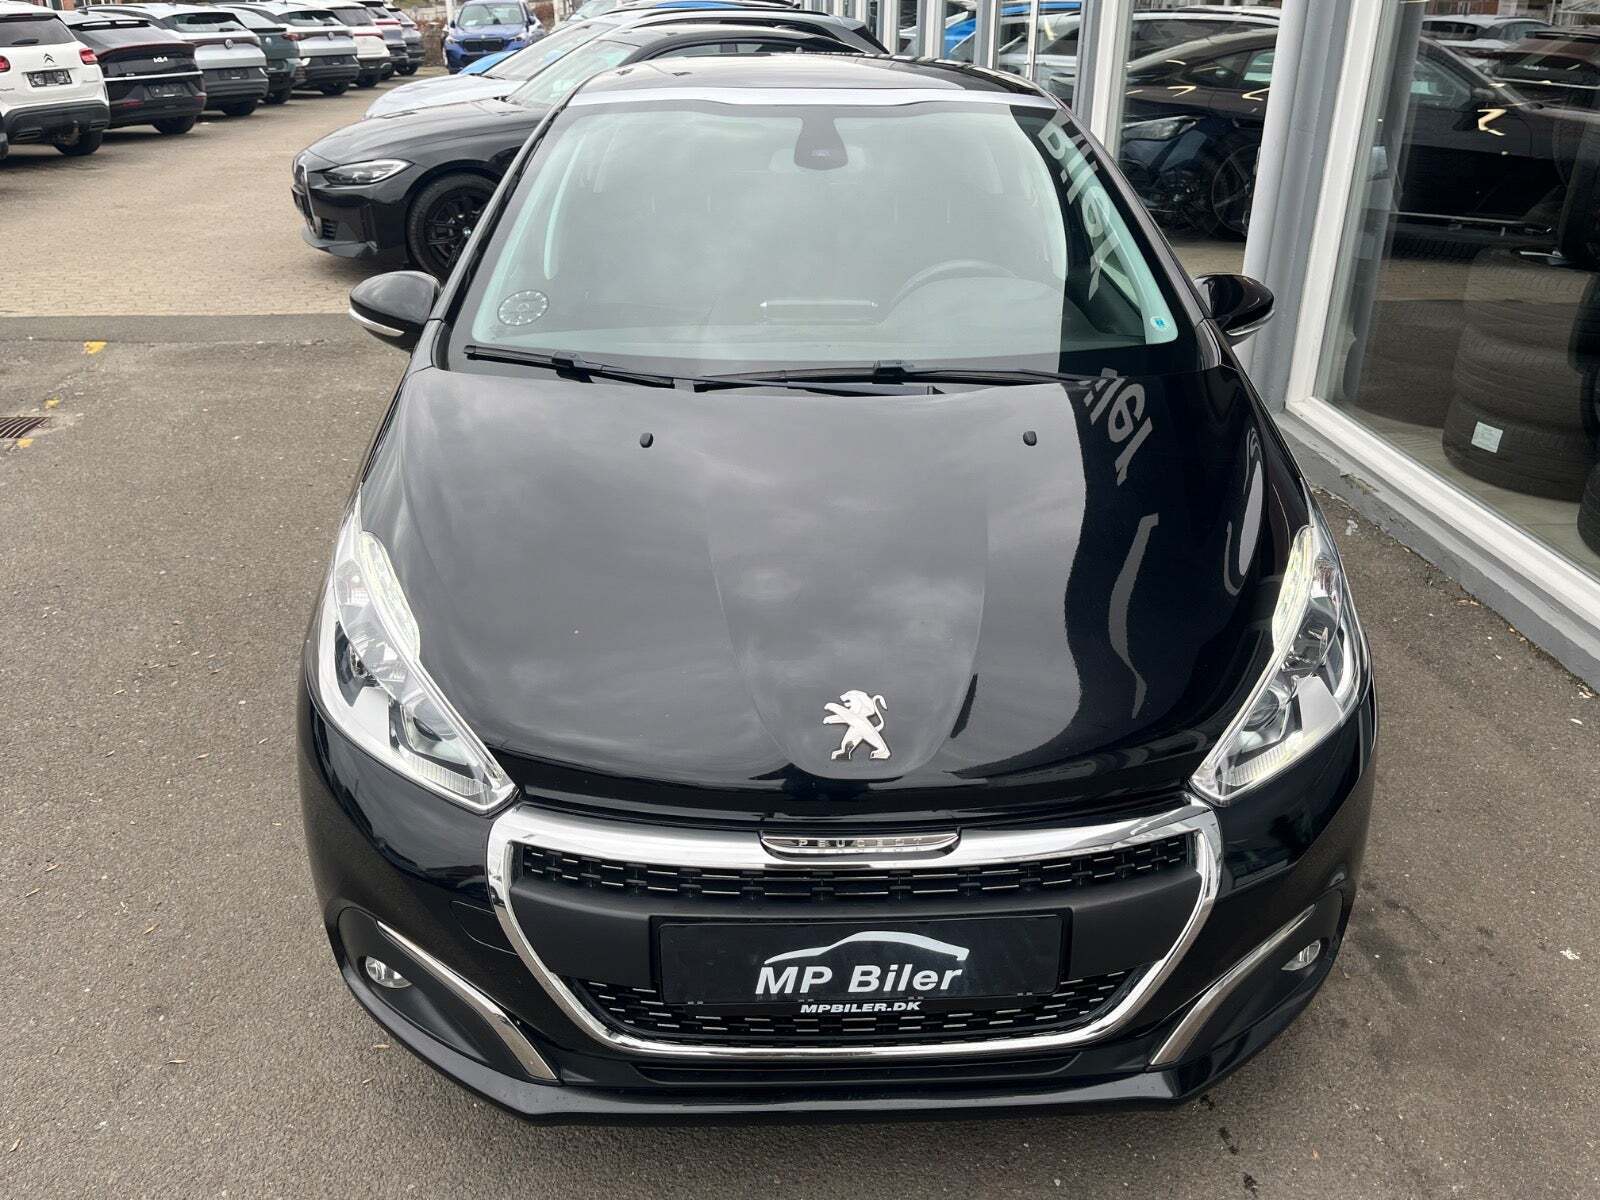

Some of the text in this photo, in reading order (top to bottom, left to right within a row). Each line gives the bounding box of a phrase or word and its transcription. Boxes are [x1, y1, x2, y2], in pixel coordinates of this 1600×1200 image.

[755, 963, 963, 995] MP Biler
[800, 1001, 922, 1014] MPBILER.DK
